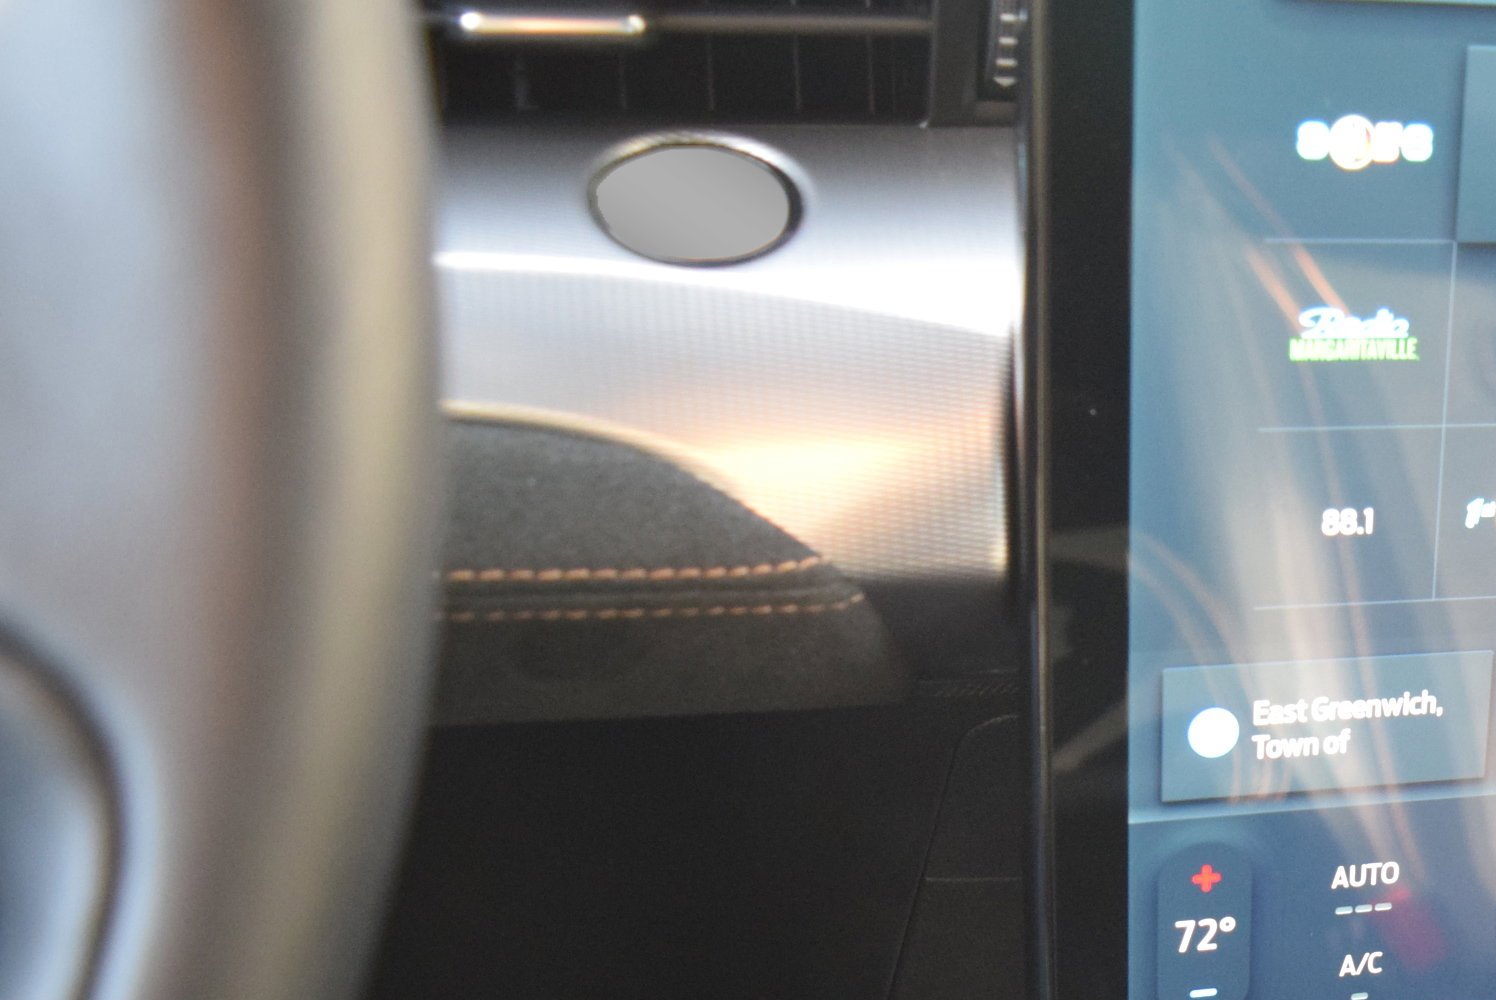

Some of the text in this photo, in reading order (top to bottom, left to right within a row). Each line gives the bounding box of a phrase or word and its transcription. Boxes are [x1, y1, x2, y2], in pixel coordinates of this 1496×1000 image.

[1321, 507, 1374, 536] 88.1
[1253, 689, 1443, 726] East Greenwich,
[1252, 728, 1352, 760] Town of
[1330, 860, 1401, 890] AUTO
[1338, 951, 1384, 978] A/C
